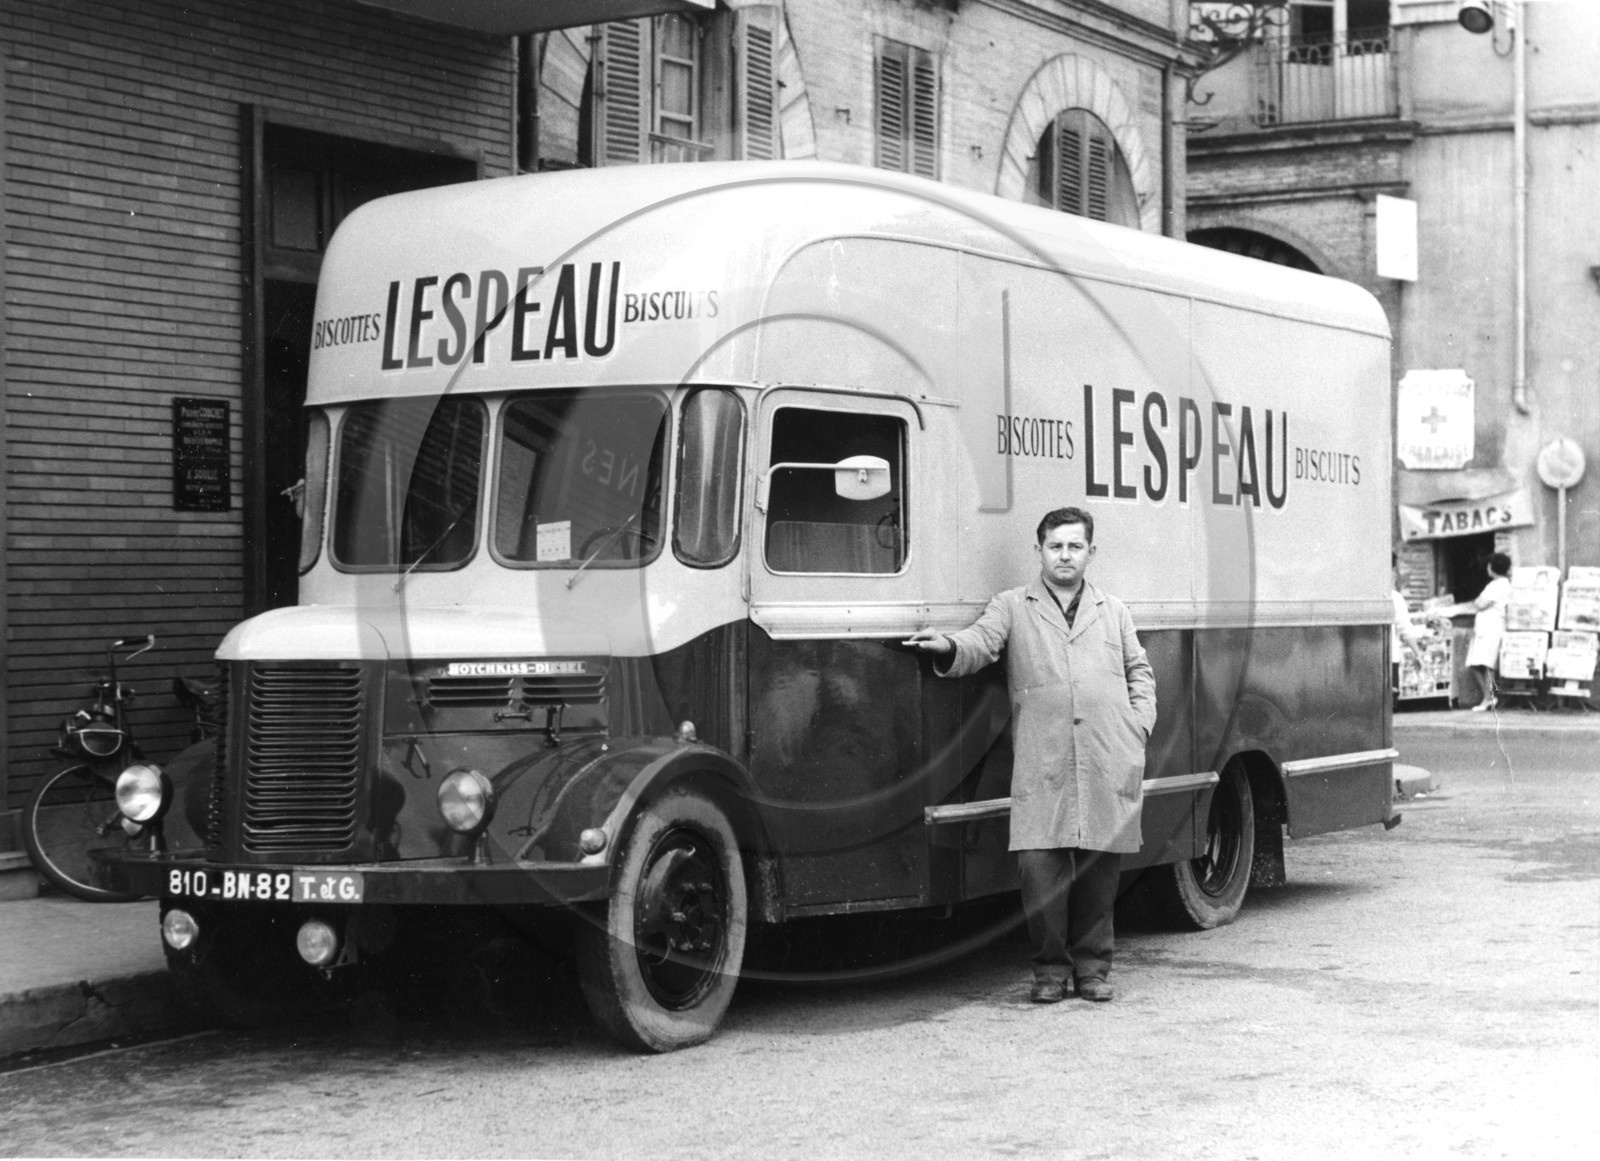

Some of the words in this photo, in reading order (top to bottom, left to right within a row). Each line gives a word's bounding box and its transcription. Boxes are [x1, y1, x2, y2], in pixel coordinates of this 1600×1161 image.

[313, 312, 381, 350] BISCOTTES
[381, 261, 621, 371] LESPEAU
[623, 290, 719, 324] BISCUITS
[996, 414, 1074, 460] BISCOTTES
[1083, 384, 1288, 509] LESPEAU
[1294, 447, 1361, 486] BISCUITS
[1422, 505, 1512, 534] TABACS
